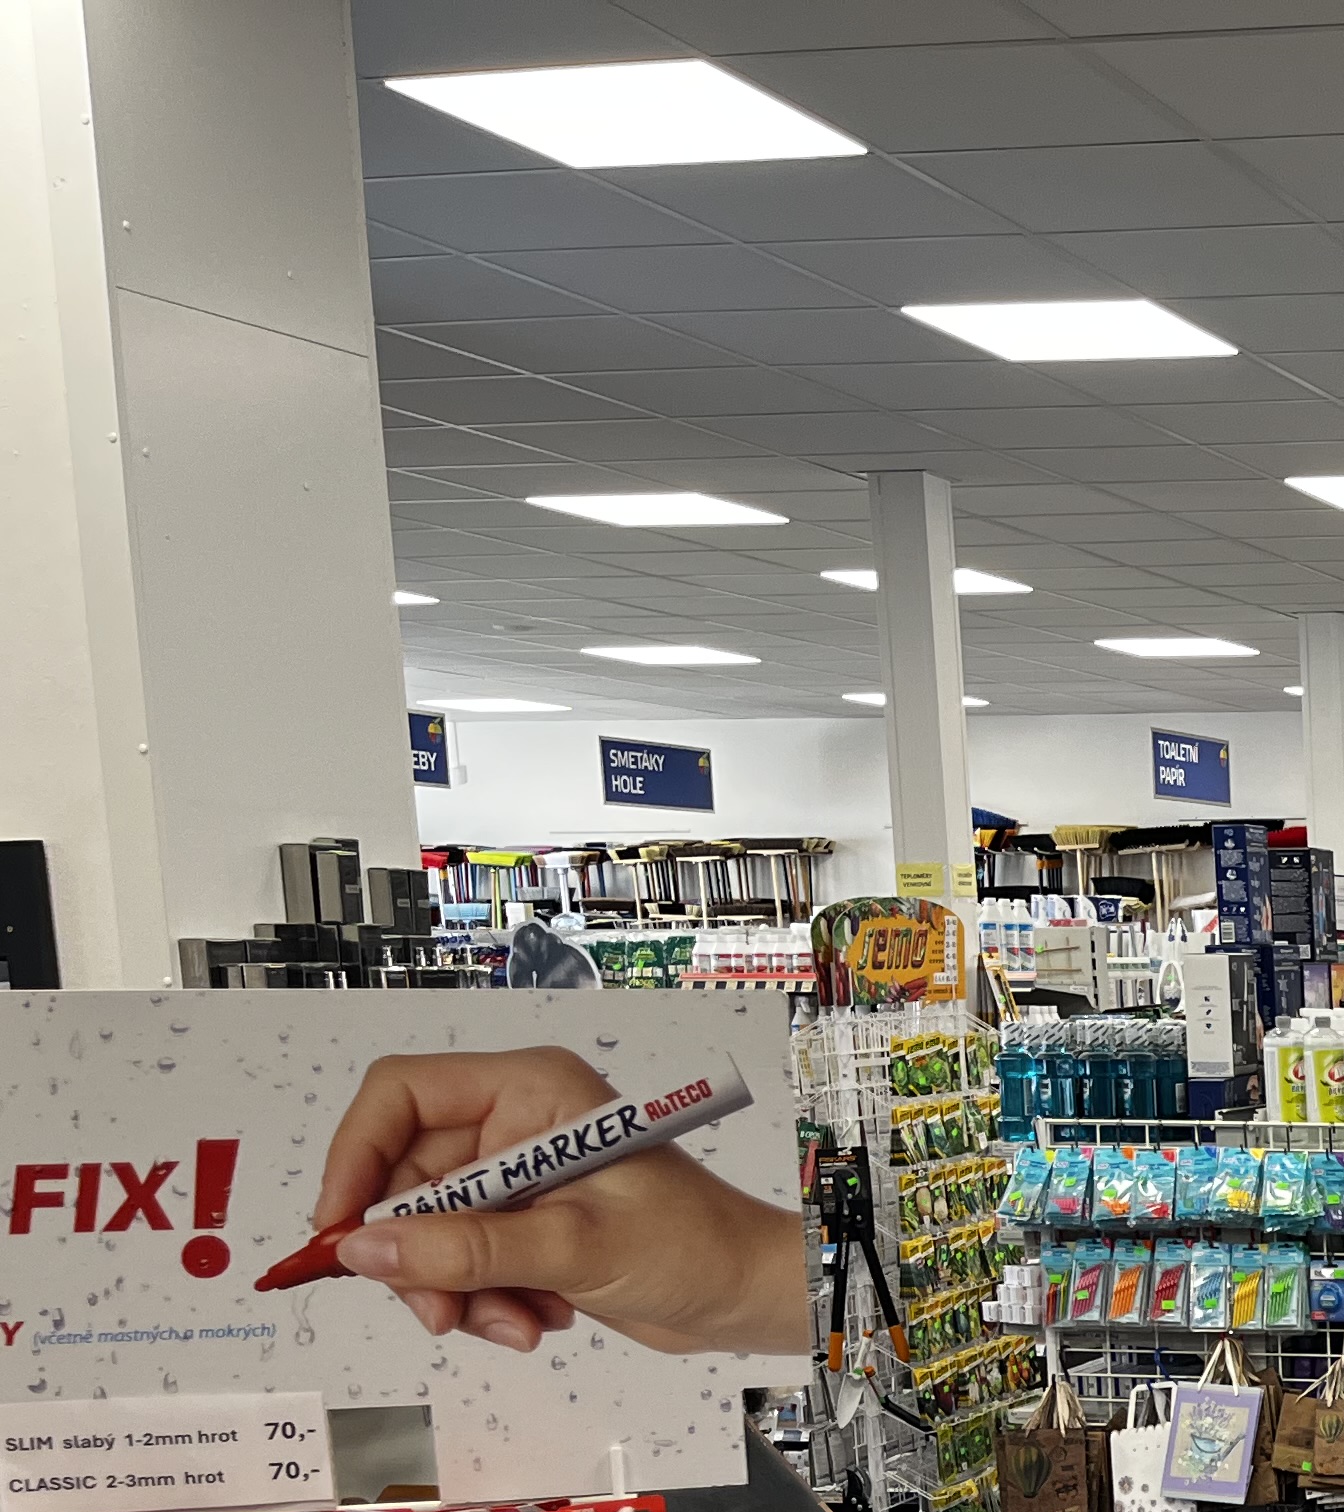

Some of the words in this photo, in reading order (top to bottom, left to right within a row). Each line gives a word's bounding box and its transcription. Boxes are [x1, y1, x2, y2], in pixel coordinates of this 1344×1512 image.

[413, 750, 437, 771] EBY
[609, 749, 665, 772] SMETÁKY
[1158, 740, 1199, 763] TOALETNÍ
[611, 775, 645, 795] HOLE
[1160, 764, 1186, 786] PAPÍR
[643, 1078, 713, 1122] ALTECO
[499, 1104, 648, 1189] MARKER
[9, 1139, 240, 1279] FIX!
[98, 1325, 177, 1343] mastných
[199, 1323, 277, 1341] mokrých)
[5, 1436, 53, 1452] SLIM
[63, 1433, 115, 1451] slabý
[124, 1433, 193, 1447] 1-2mm
[198, 1430, 238, 1445] hrot
[264, 1421, 317, 1442] 70,-
[9, 1476, 96, 1493] CLASSIC
[106, 1475, 175, 1489] 2-3mm
[184, 1471, 226, 1486] hrot
[268, 1462, 321, 1482] 70,-
